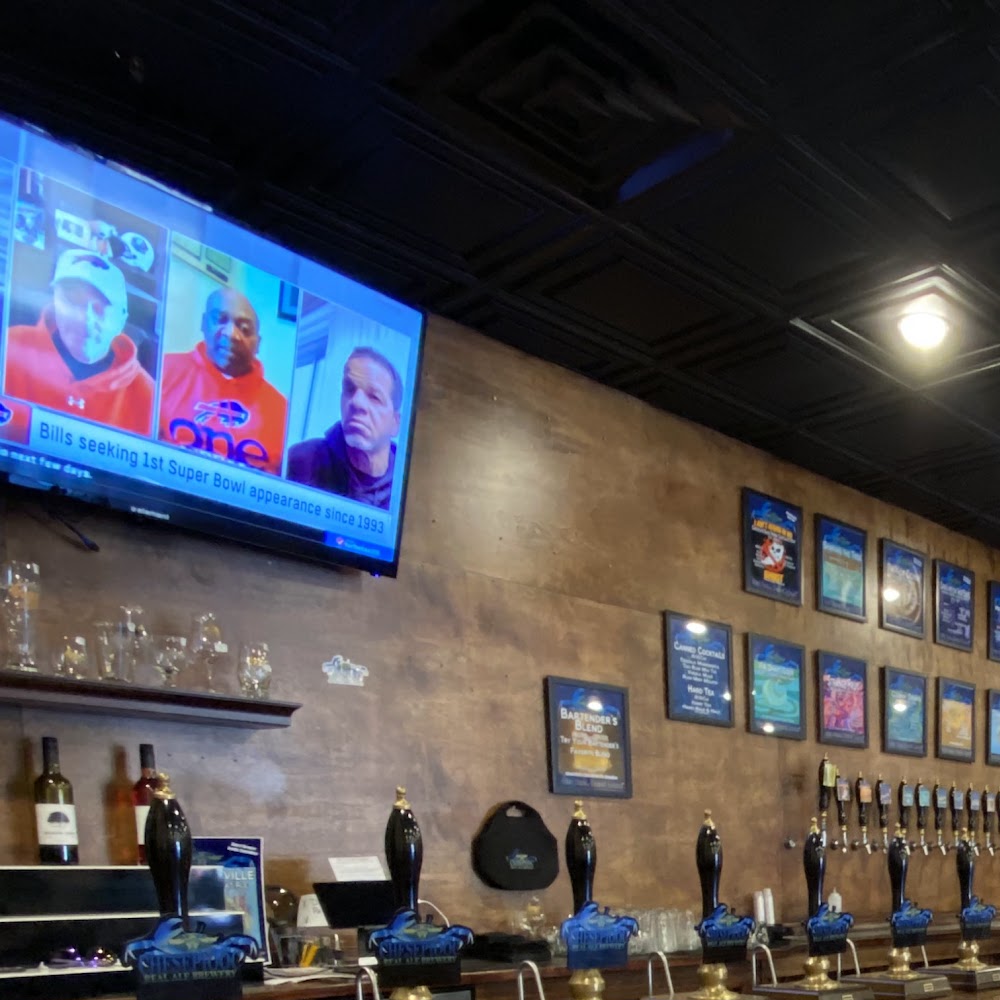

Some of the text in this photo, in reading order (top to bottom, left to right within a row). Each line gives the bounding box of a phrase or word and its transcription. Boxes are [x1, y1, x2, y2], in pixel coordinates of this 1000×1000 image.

[40, 421, 385, 535] Bills seeking 1st Super Bowl appearance since 1993
[560, 707, 618, 726] BARTENDER'S
[574, 720, 603, 733] BLEND
